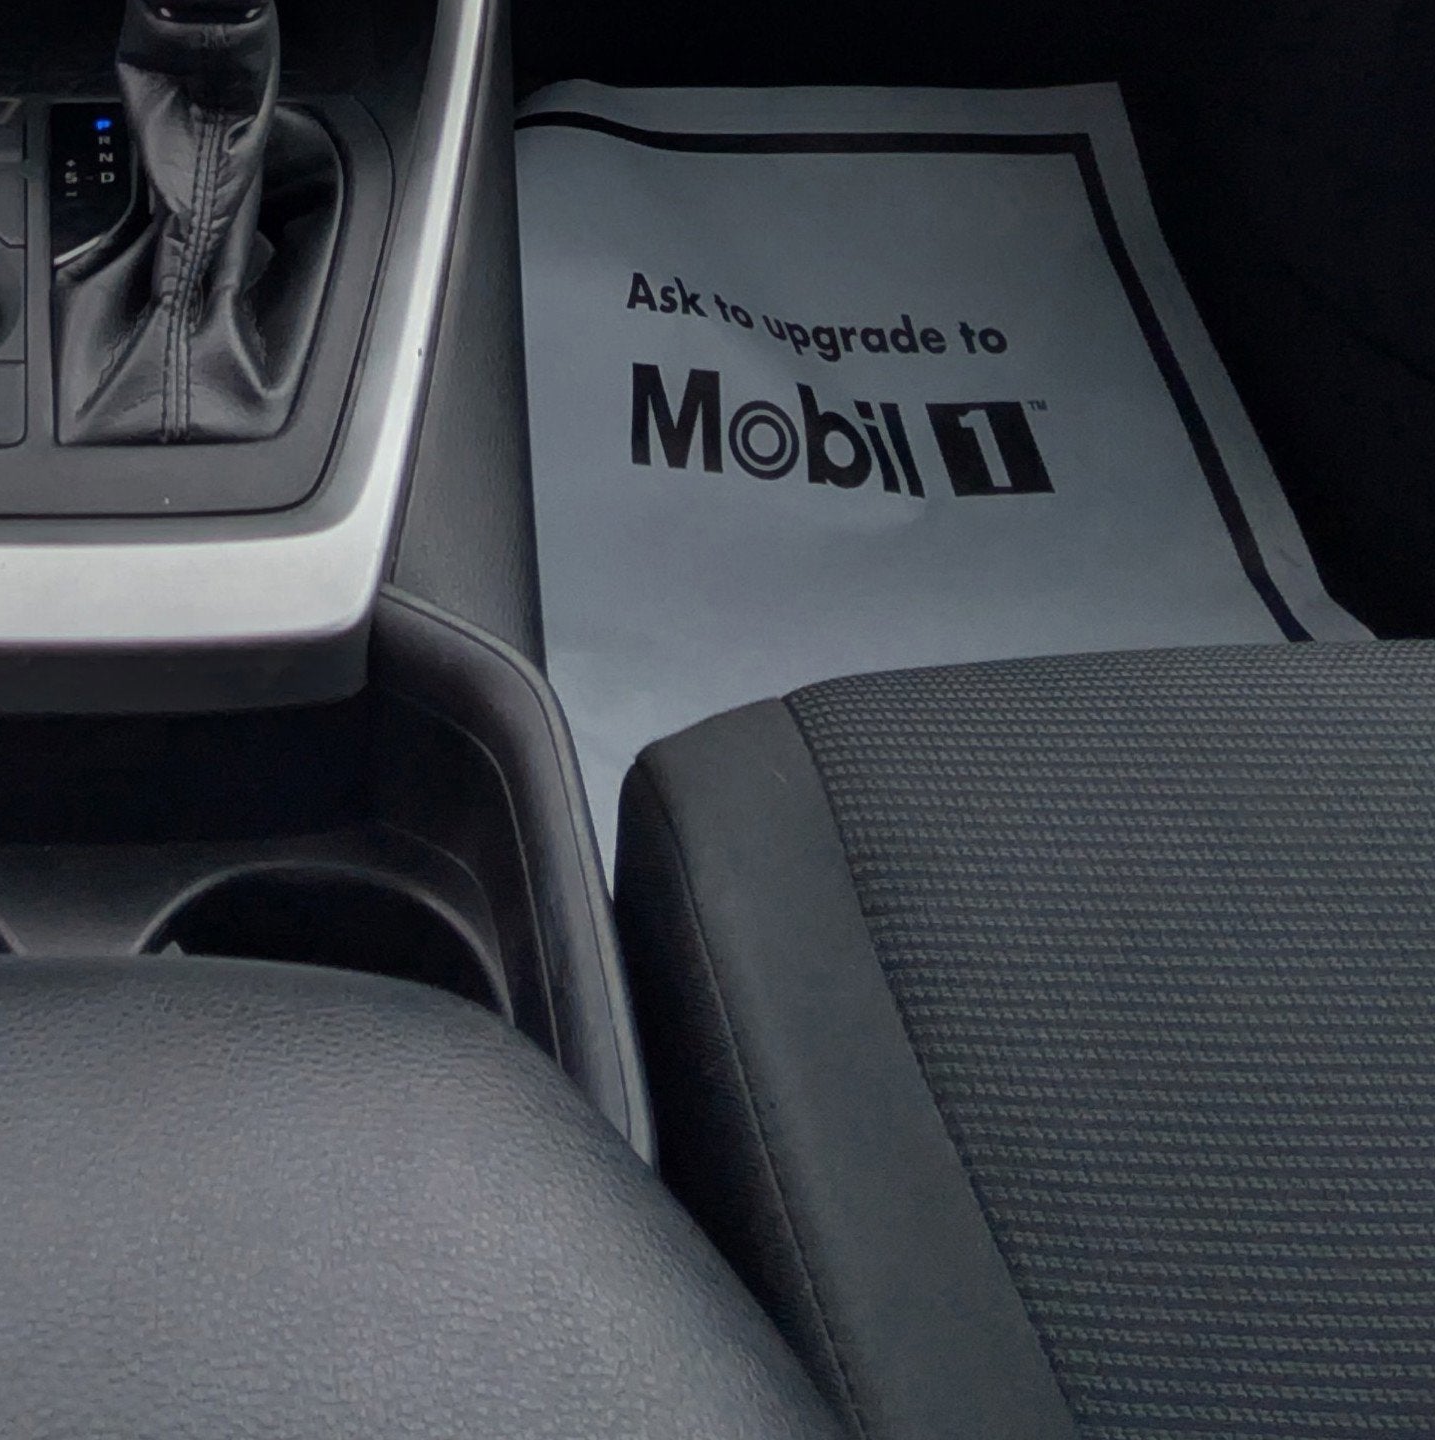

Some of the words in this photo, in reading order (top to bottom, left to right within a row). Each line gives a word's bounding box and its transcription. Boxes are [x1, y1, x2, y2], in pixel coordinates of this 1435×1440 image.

[98, 152, 114, 163] N
[100, 171, 115, 184] D
[625, 272, 707, 319] Ask
[713, 293, 754, 330] to
[764, 312, 946, 362] upgrade
[959, 317, 1008, 354] to
[630, 362, 925, 498] Mobil
